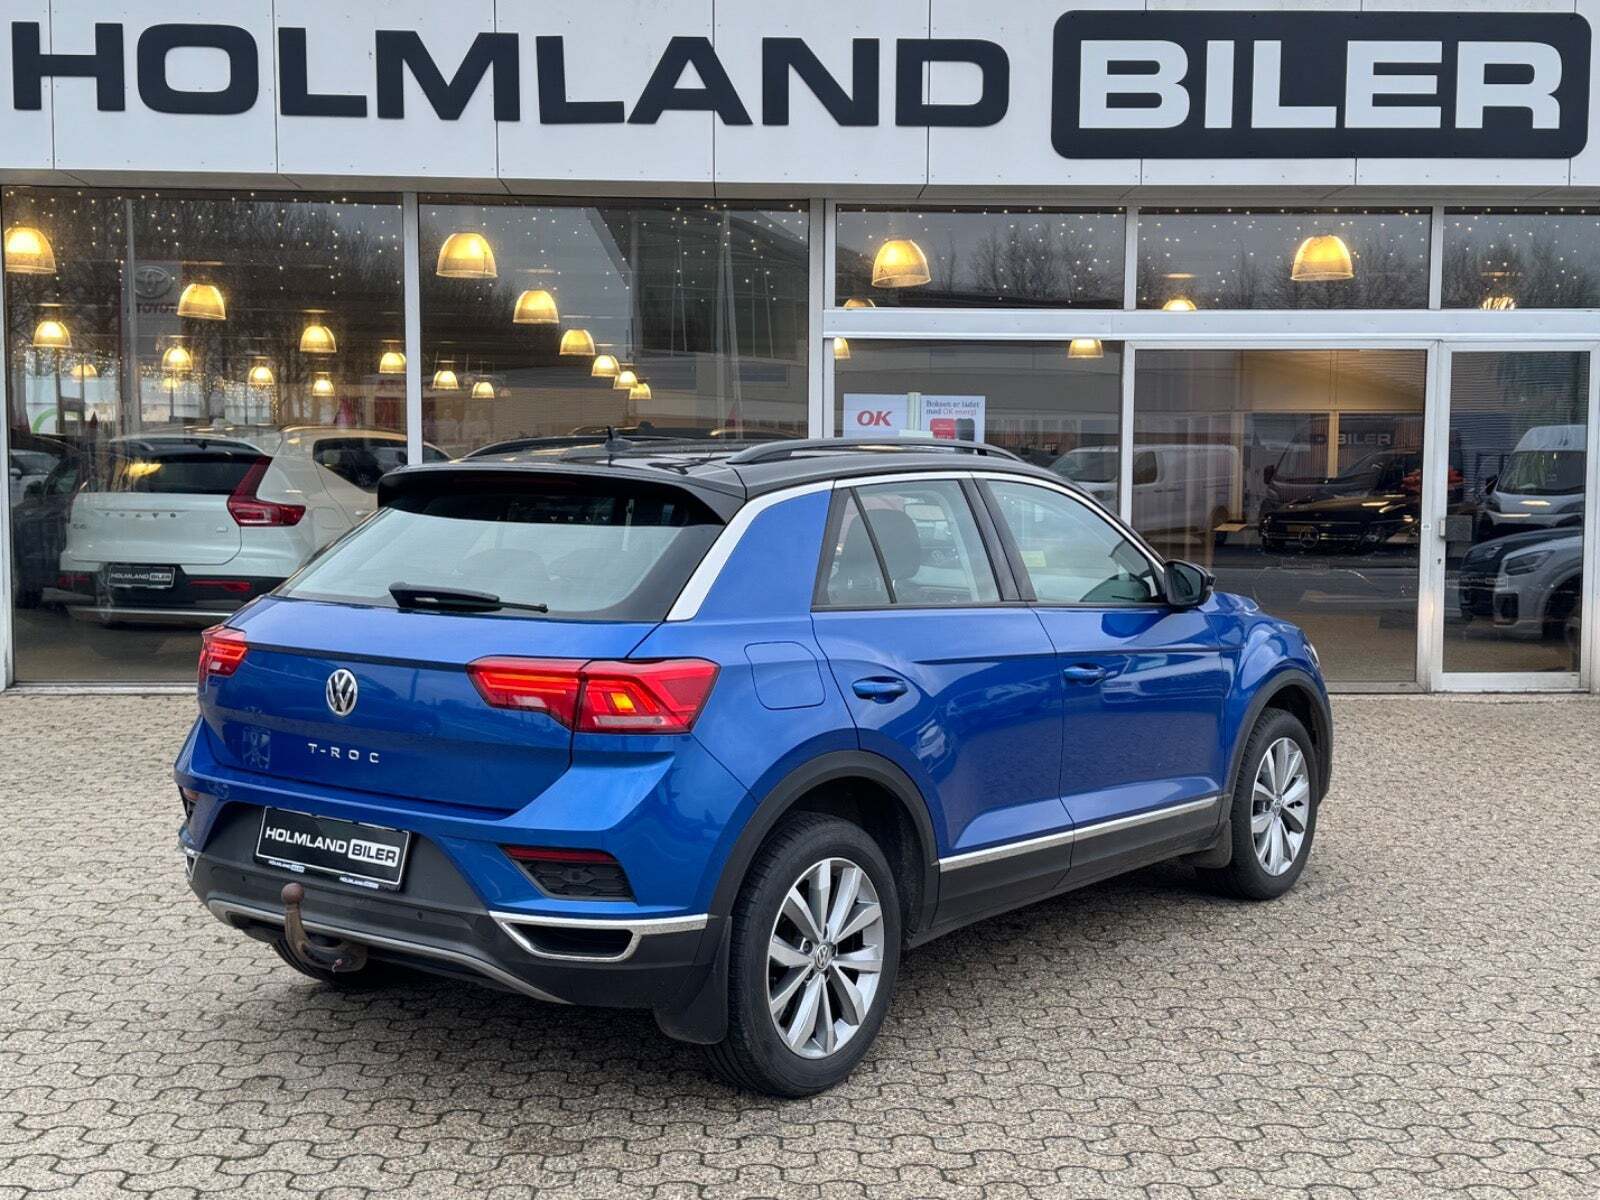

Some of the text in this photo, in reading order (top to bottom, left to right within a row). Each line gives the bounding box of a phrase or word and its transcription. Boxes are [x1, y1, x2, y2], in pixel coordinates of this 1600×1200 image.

[12, 22, 1562, 129] HOLMLAND BILER
[857, 410, 892, 426] OK
[308, 742, 380, 764] T-ROC
[265, 826, 398, 864] HOLMLAND BILER
